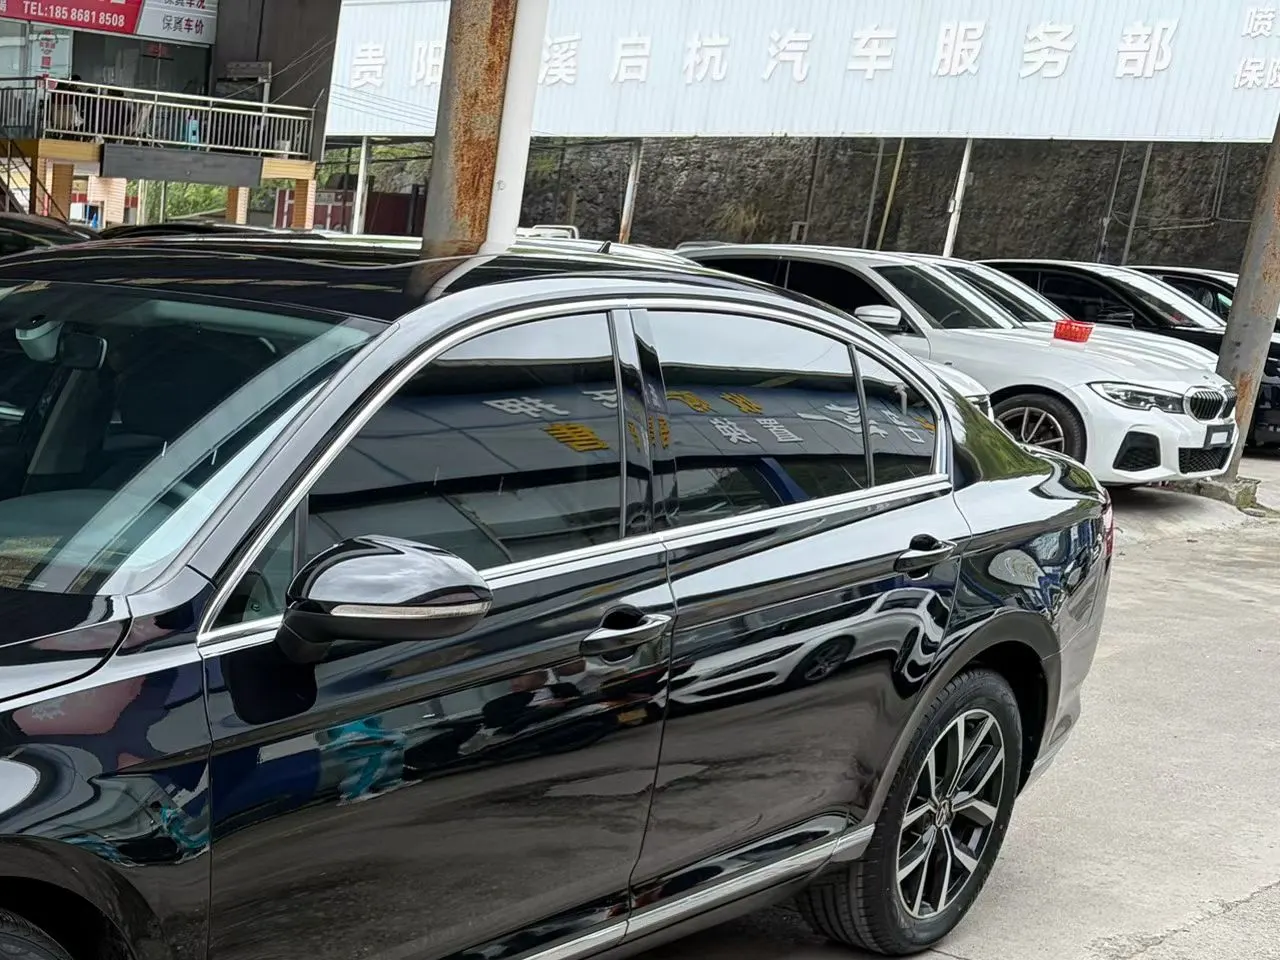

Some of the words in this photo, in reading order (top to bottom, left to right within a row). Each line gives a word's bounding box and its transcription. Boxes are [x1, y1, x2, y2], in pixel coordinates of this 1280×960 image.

[70, 8, 96, 23] 8681
[98, 12, 125, 27] 8508
[349, 18, 1180, 89] 贵阳溪启杭汽车服务部
